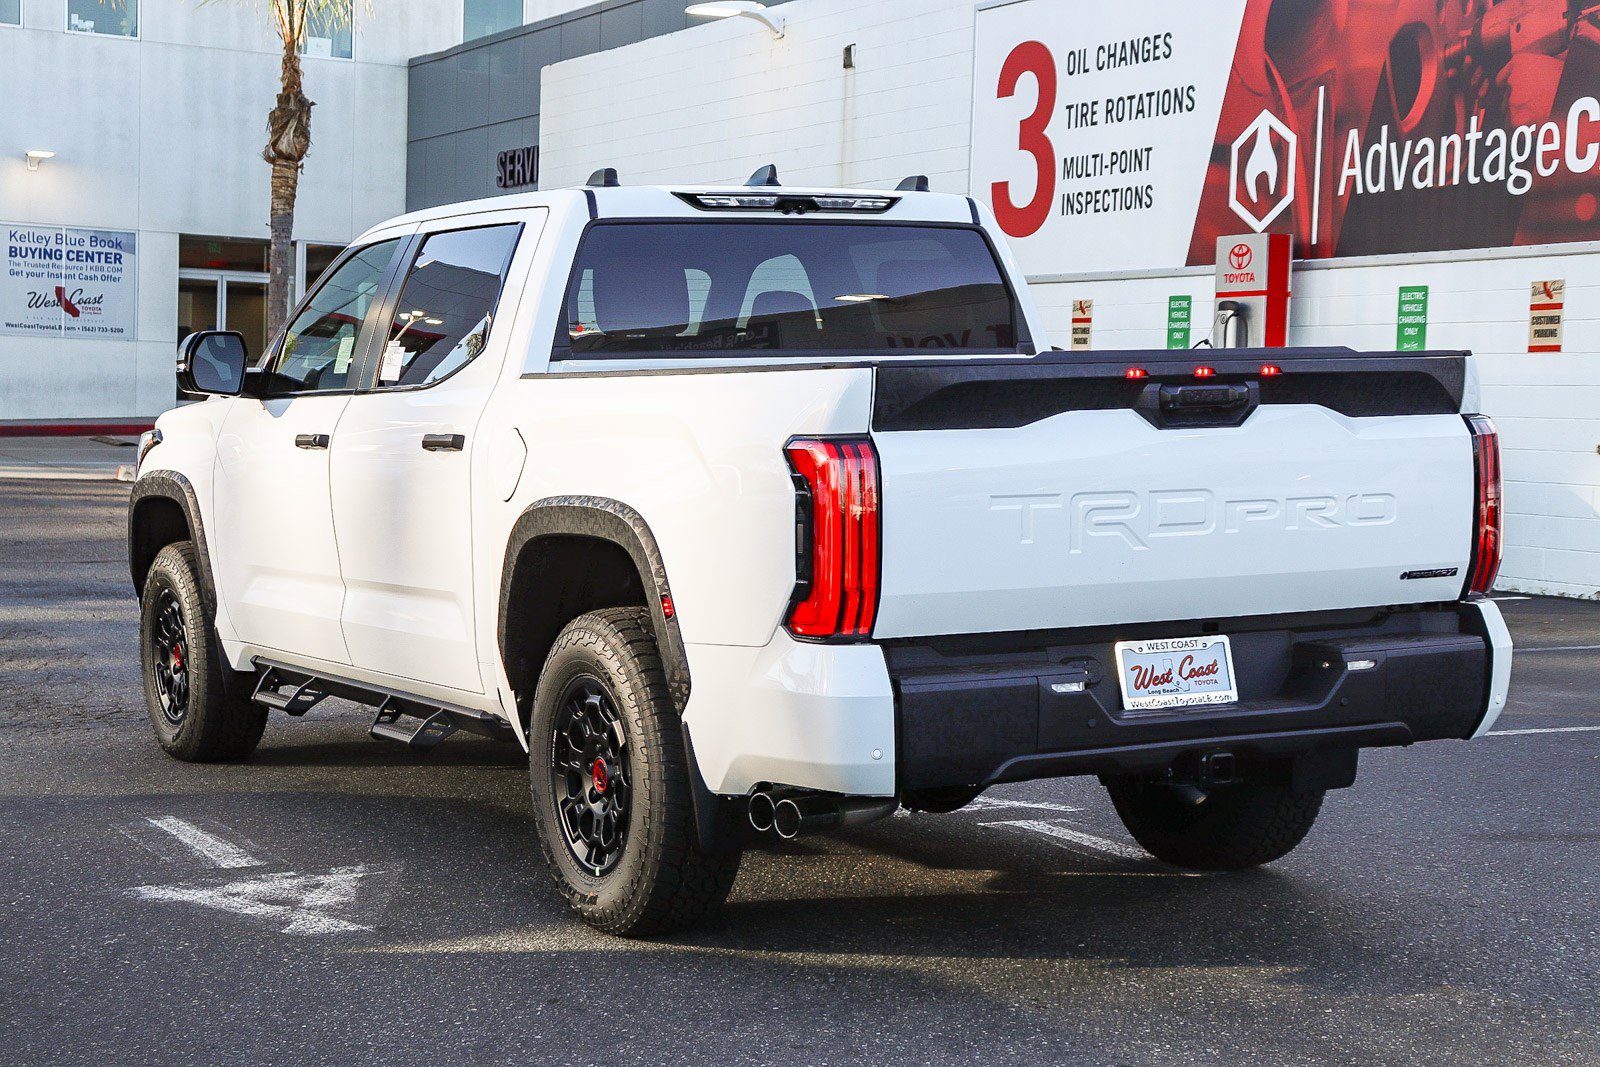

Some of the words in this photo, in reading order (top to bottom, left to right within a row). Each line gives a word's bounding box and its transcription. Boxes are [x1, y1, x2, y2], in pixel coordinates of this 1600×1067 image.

[1067, 48, 1089, 76] OIL
[1096, 32, 1172, 71] CHANGES
[1066, 100, 1099, 129] TIRE
[1105, 85, 1196, 124] ROTATIONS
[992, 40, 1057, 238] 3
[1062, 147, 1153, 180] MULTI-POINT
[1061, 184, 1154, 216] INSPECTIONS
[9, 230, 51, 247] Kelley
[55, 233, 85, 247] Blue
[90, 236, 123, 250] Book
[9, 246, 63, 261] BUYING
[66, 250, 123, 265] CENTER
[24, 261, 50, 269] Trusted
[90, 265, 123, 274] KBB.COM
[9, 269, 23, 277] Get
[26, 271, 45, 279] your
[78, 273, 99, 282] Cash
[101, 274, 122, 283] Offer
[1224, 272, 1256, 283] TOYOTA
[27, 291, 63, 309] West
[70, 288, 104, 305] Coast
[1401, 292, 1425, 300] ELECTRIC
[1170, 300, 1189, 308] ELECTRIC
[1402, 304, 1424, 312] VEHICLE
[1171, 311, 1188, 319] VEHICLE
[1399, 315, 1426, 324] CHARGING
[1531, 315, 1561, 325] CUSTOMER
[5, 322, 77, 332] WestCoastToyotaLBcom
[1169, 321, 1190, 329] CHARGING
[1404, 327, 1419, 336] ONLY
[1533, 329, 1558, 338] PARKING
[989, 488, 1216, 554] TRD
[1225, 493, 1397, 534] PRO
[1146, 641, 1169, 650] WEST
[1171, 640, 1198, 649] COAST
[1130, 664, 1174, 690] West
[1178, 655, 1219, 681] Coast
[1130, 694, 1232, 708] WestCoastToyotaLB.com
